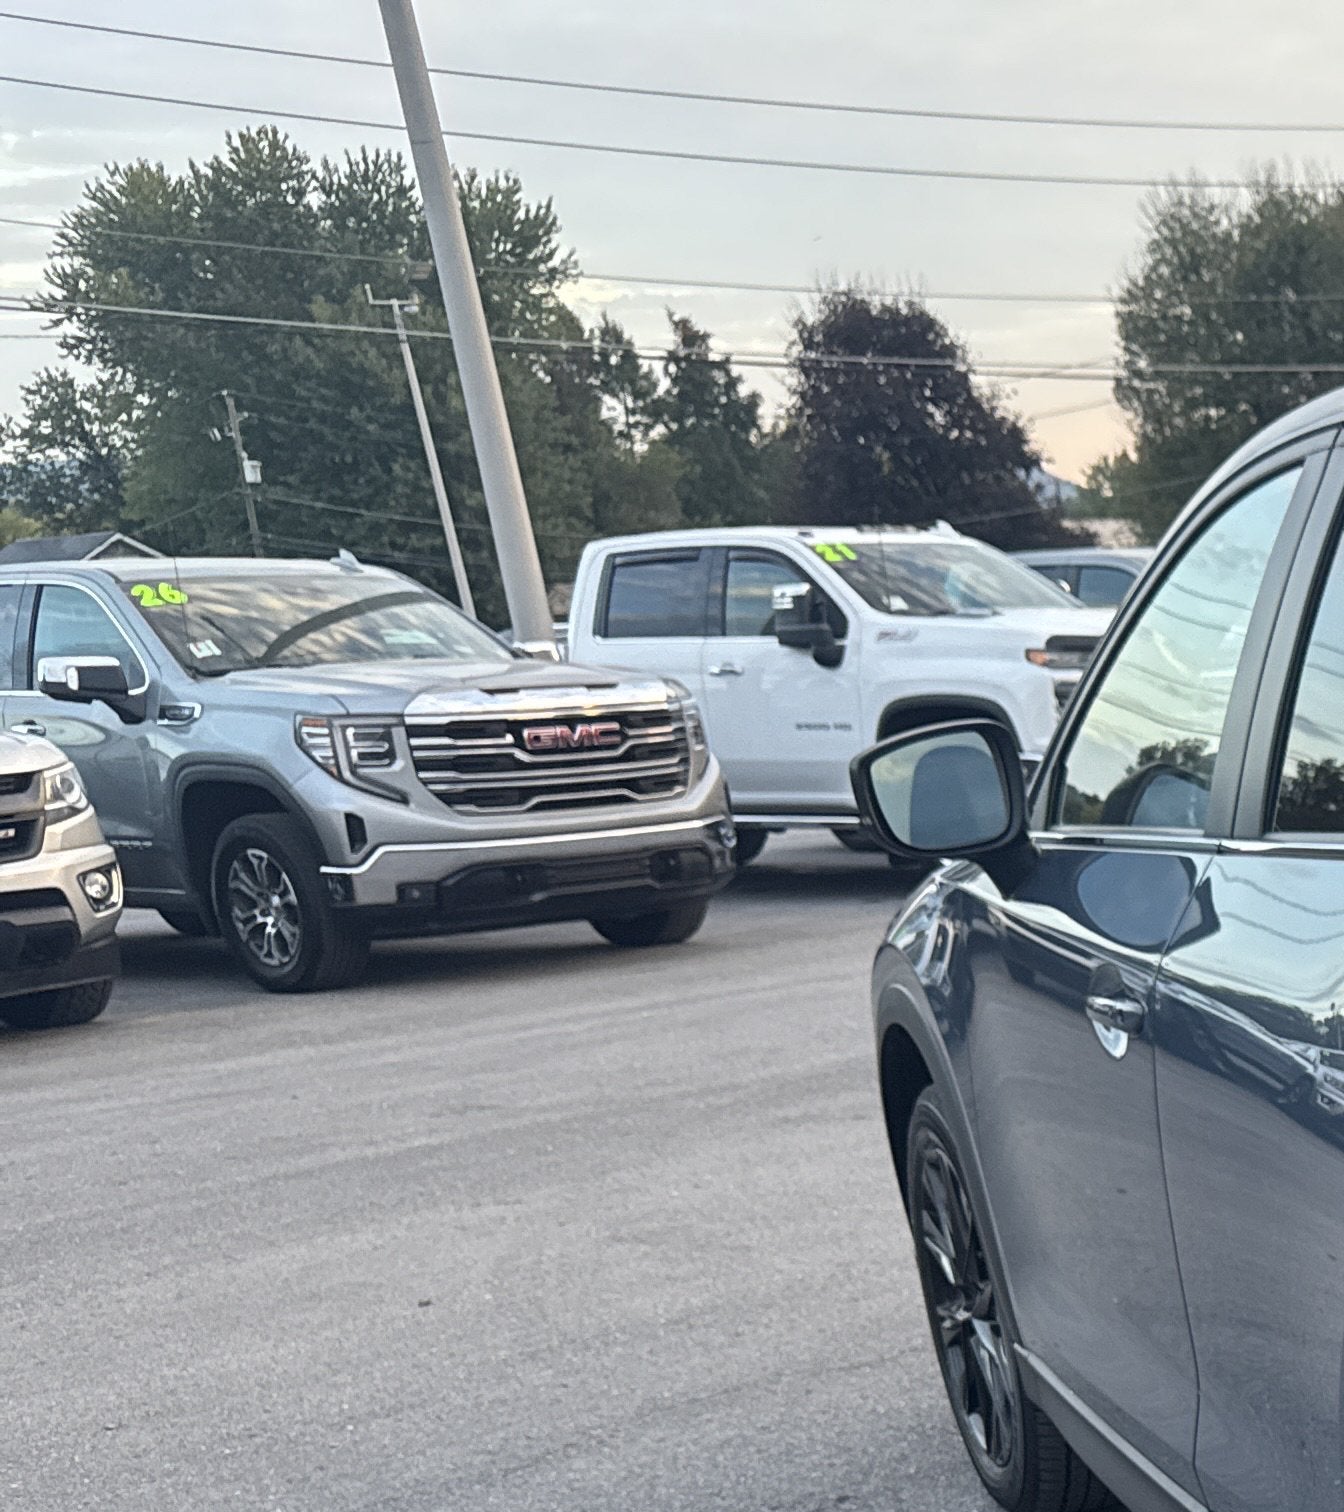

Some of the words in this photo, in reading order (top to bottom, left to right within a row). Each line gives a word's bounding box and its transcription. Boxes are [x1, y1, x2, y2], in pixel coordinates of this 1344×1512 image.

[815, 543, 857, 562] 21
[130, 582, 188, 607] 26
[523, 721, 621, 750] GMC
